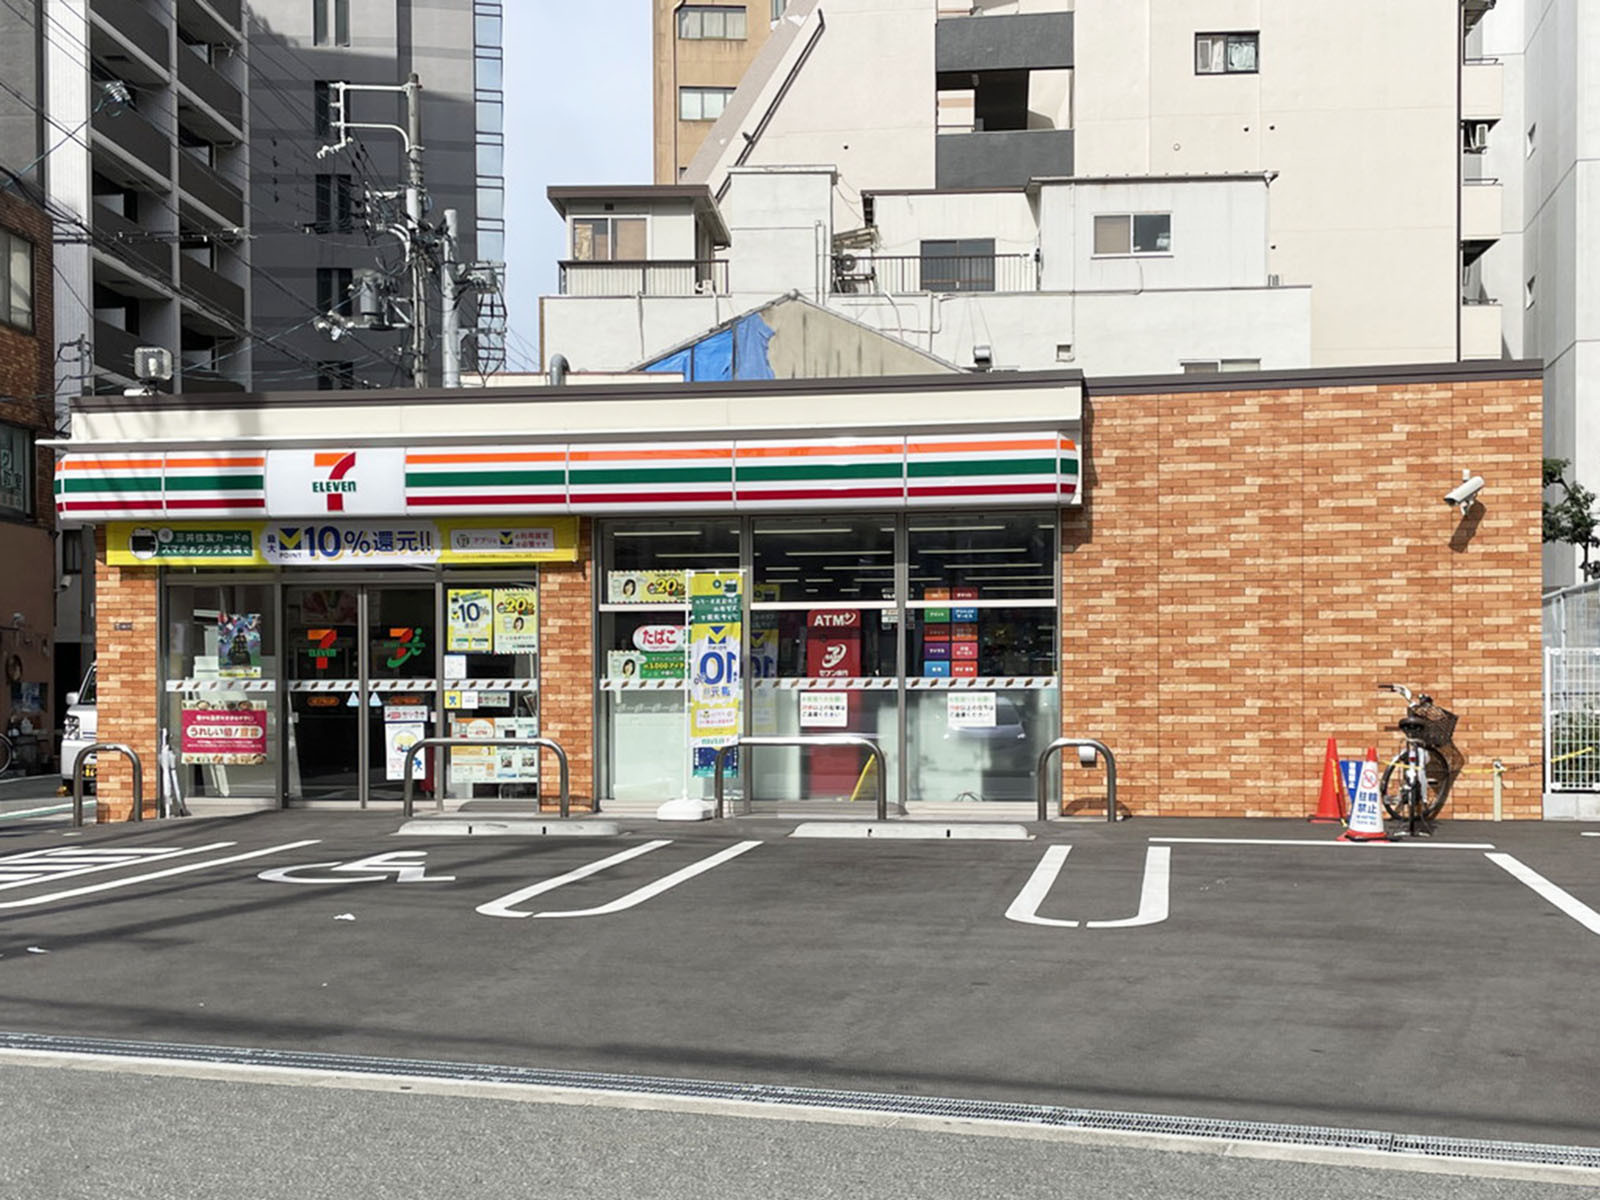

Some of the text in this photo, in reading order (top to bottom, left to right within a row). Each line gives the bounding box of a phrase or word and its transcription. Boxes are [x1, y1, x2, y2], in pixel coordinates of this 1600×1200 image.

[813, 613, 844, 627] ATM
[642, 629, 677, 645] たばこ
